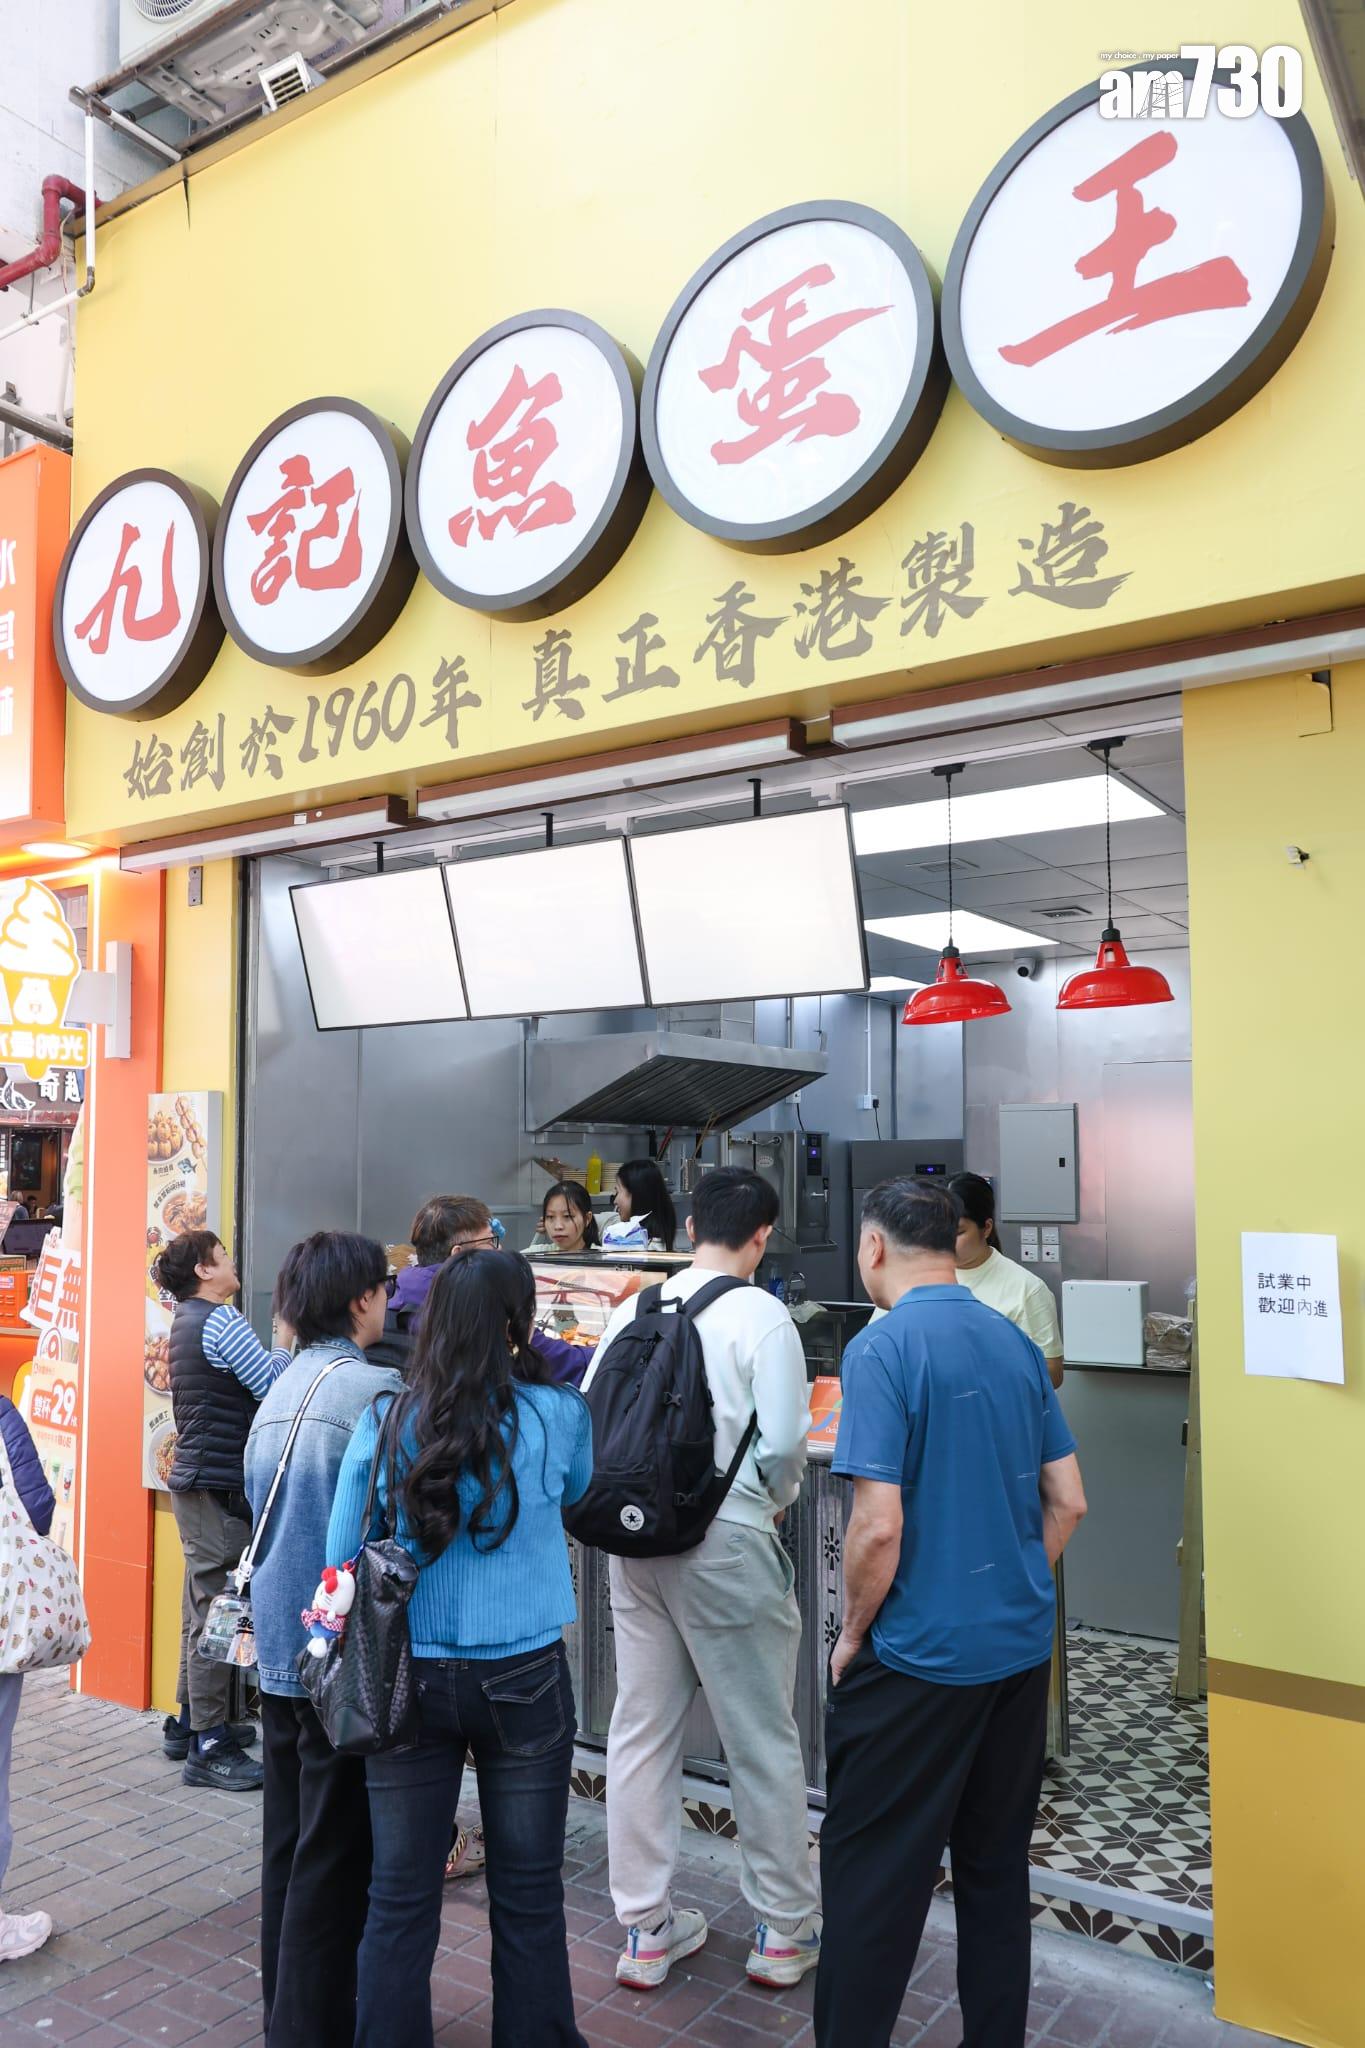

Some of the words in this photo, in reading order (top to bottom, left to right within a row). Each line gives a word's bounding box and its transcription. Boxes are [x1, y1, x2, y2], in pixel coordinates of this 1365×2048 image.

[123, 655, 482, 801] 始創於1960年
[521, 501, 1136, 722] 真正香港製造
[1257, 1272, 1312, 1292] 試業中
[1258, 1297, 1329, 1318] 歡迎內進
